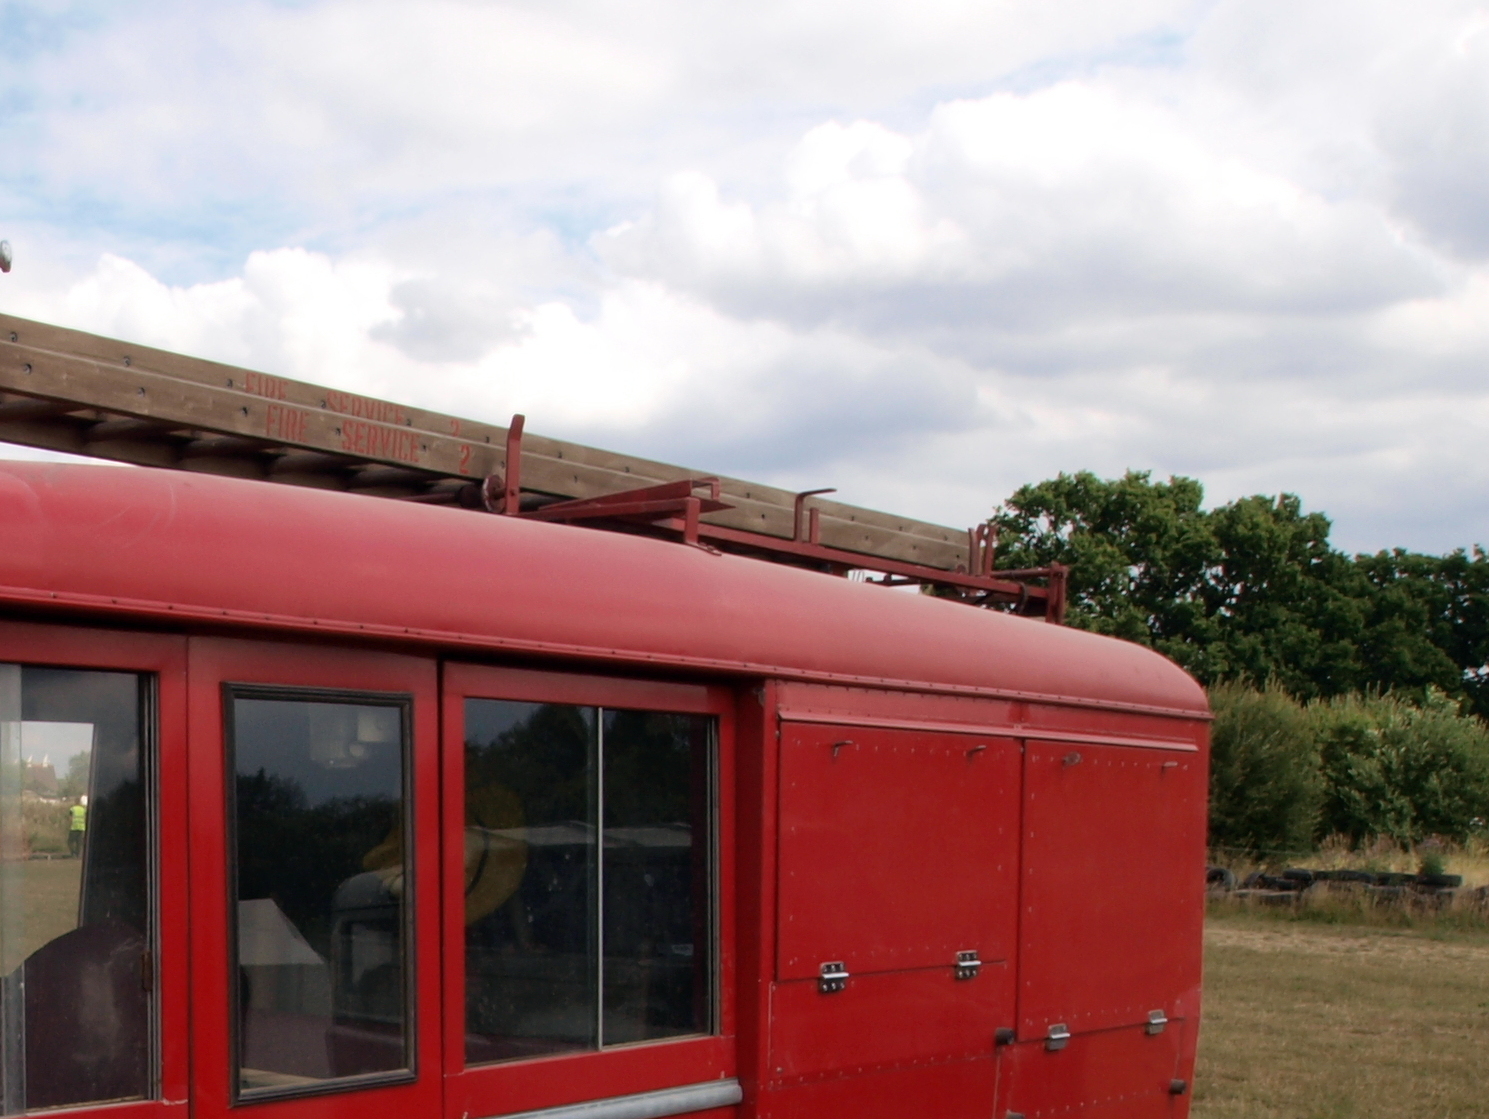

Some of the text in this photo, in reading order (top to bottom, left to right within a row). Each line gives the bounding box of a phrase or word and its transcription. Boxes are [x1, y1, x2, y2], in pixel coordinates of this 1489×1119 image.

[266, 404, 471, 474] FIRE SERVICE 2
